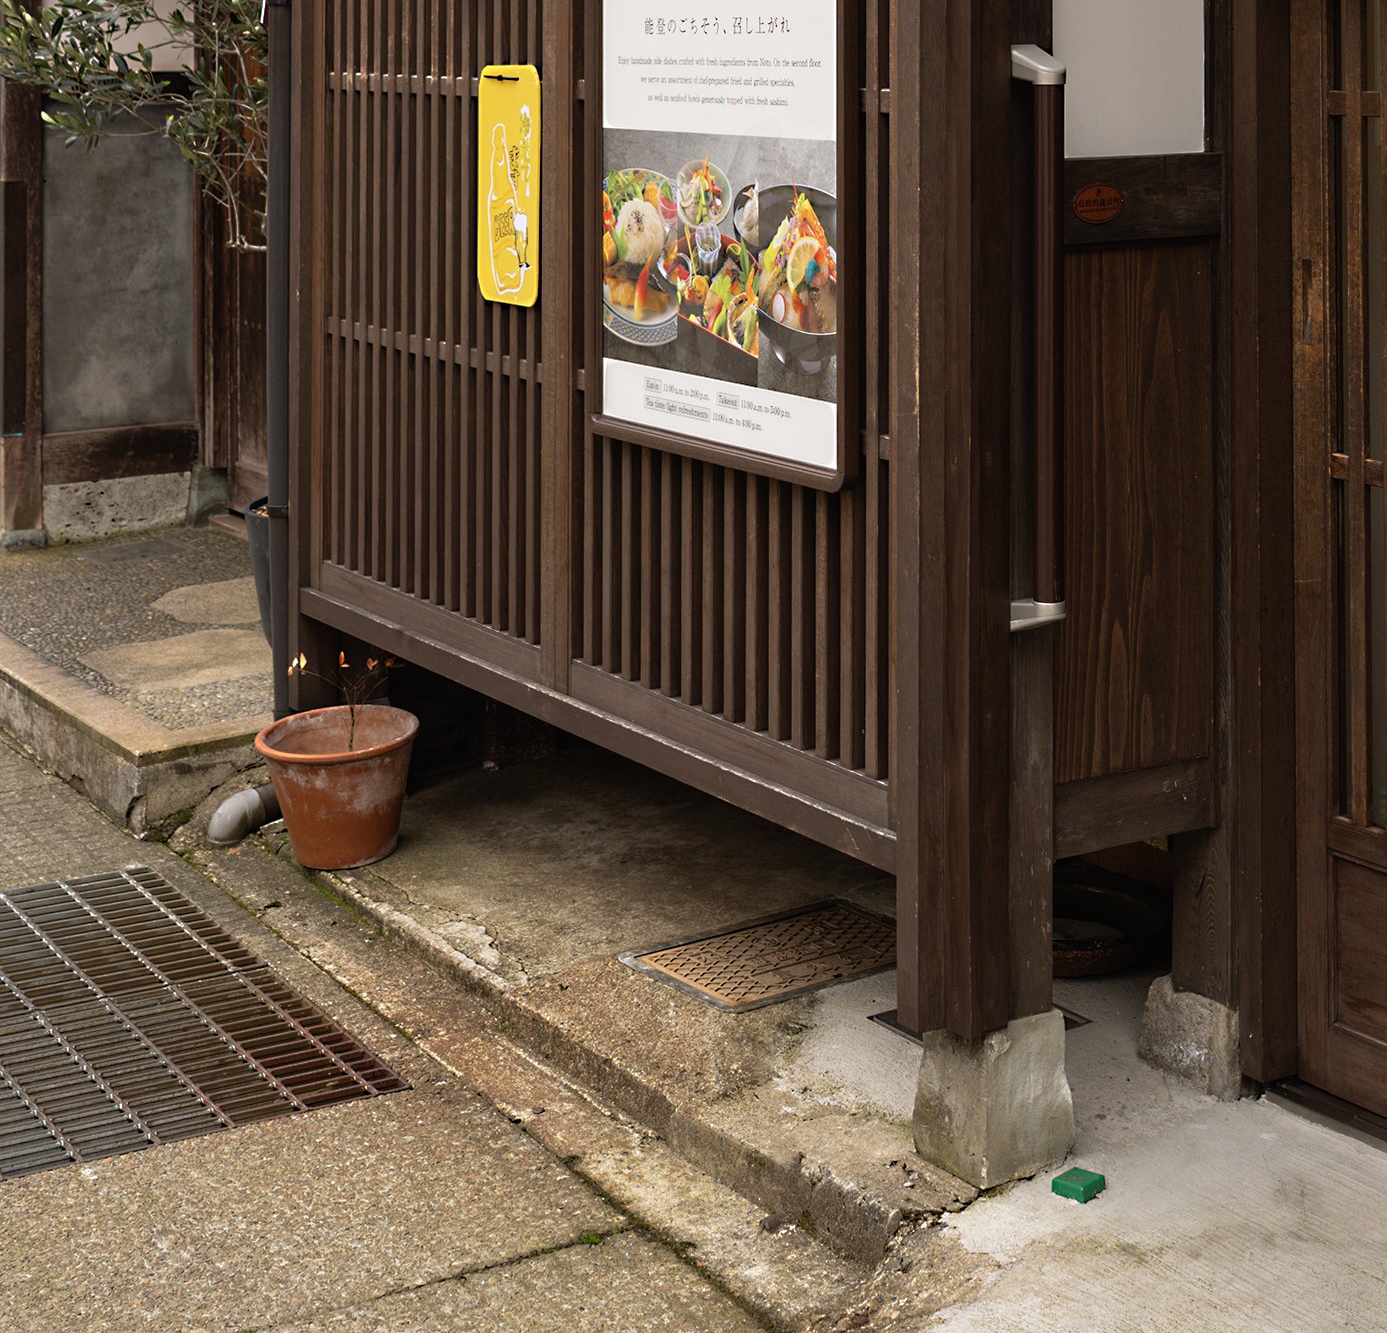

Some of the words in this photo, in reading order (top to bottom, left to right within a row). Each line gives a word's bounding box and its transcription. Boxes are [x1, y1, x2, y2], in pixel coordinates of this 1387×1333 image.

[644, 17, 792, 35] 能登のごちそう、召し上がれ
